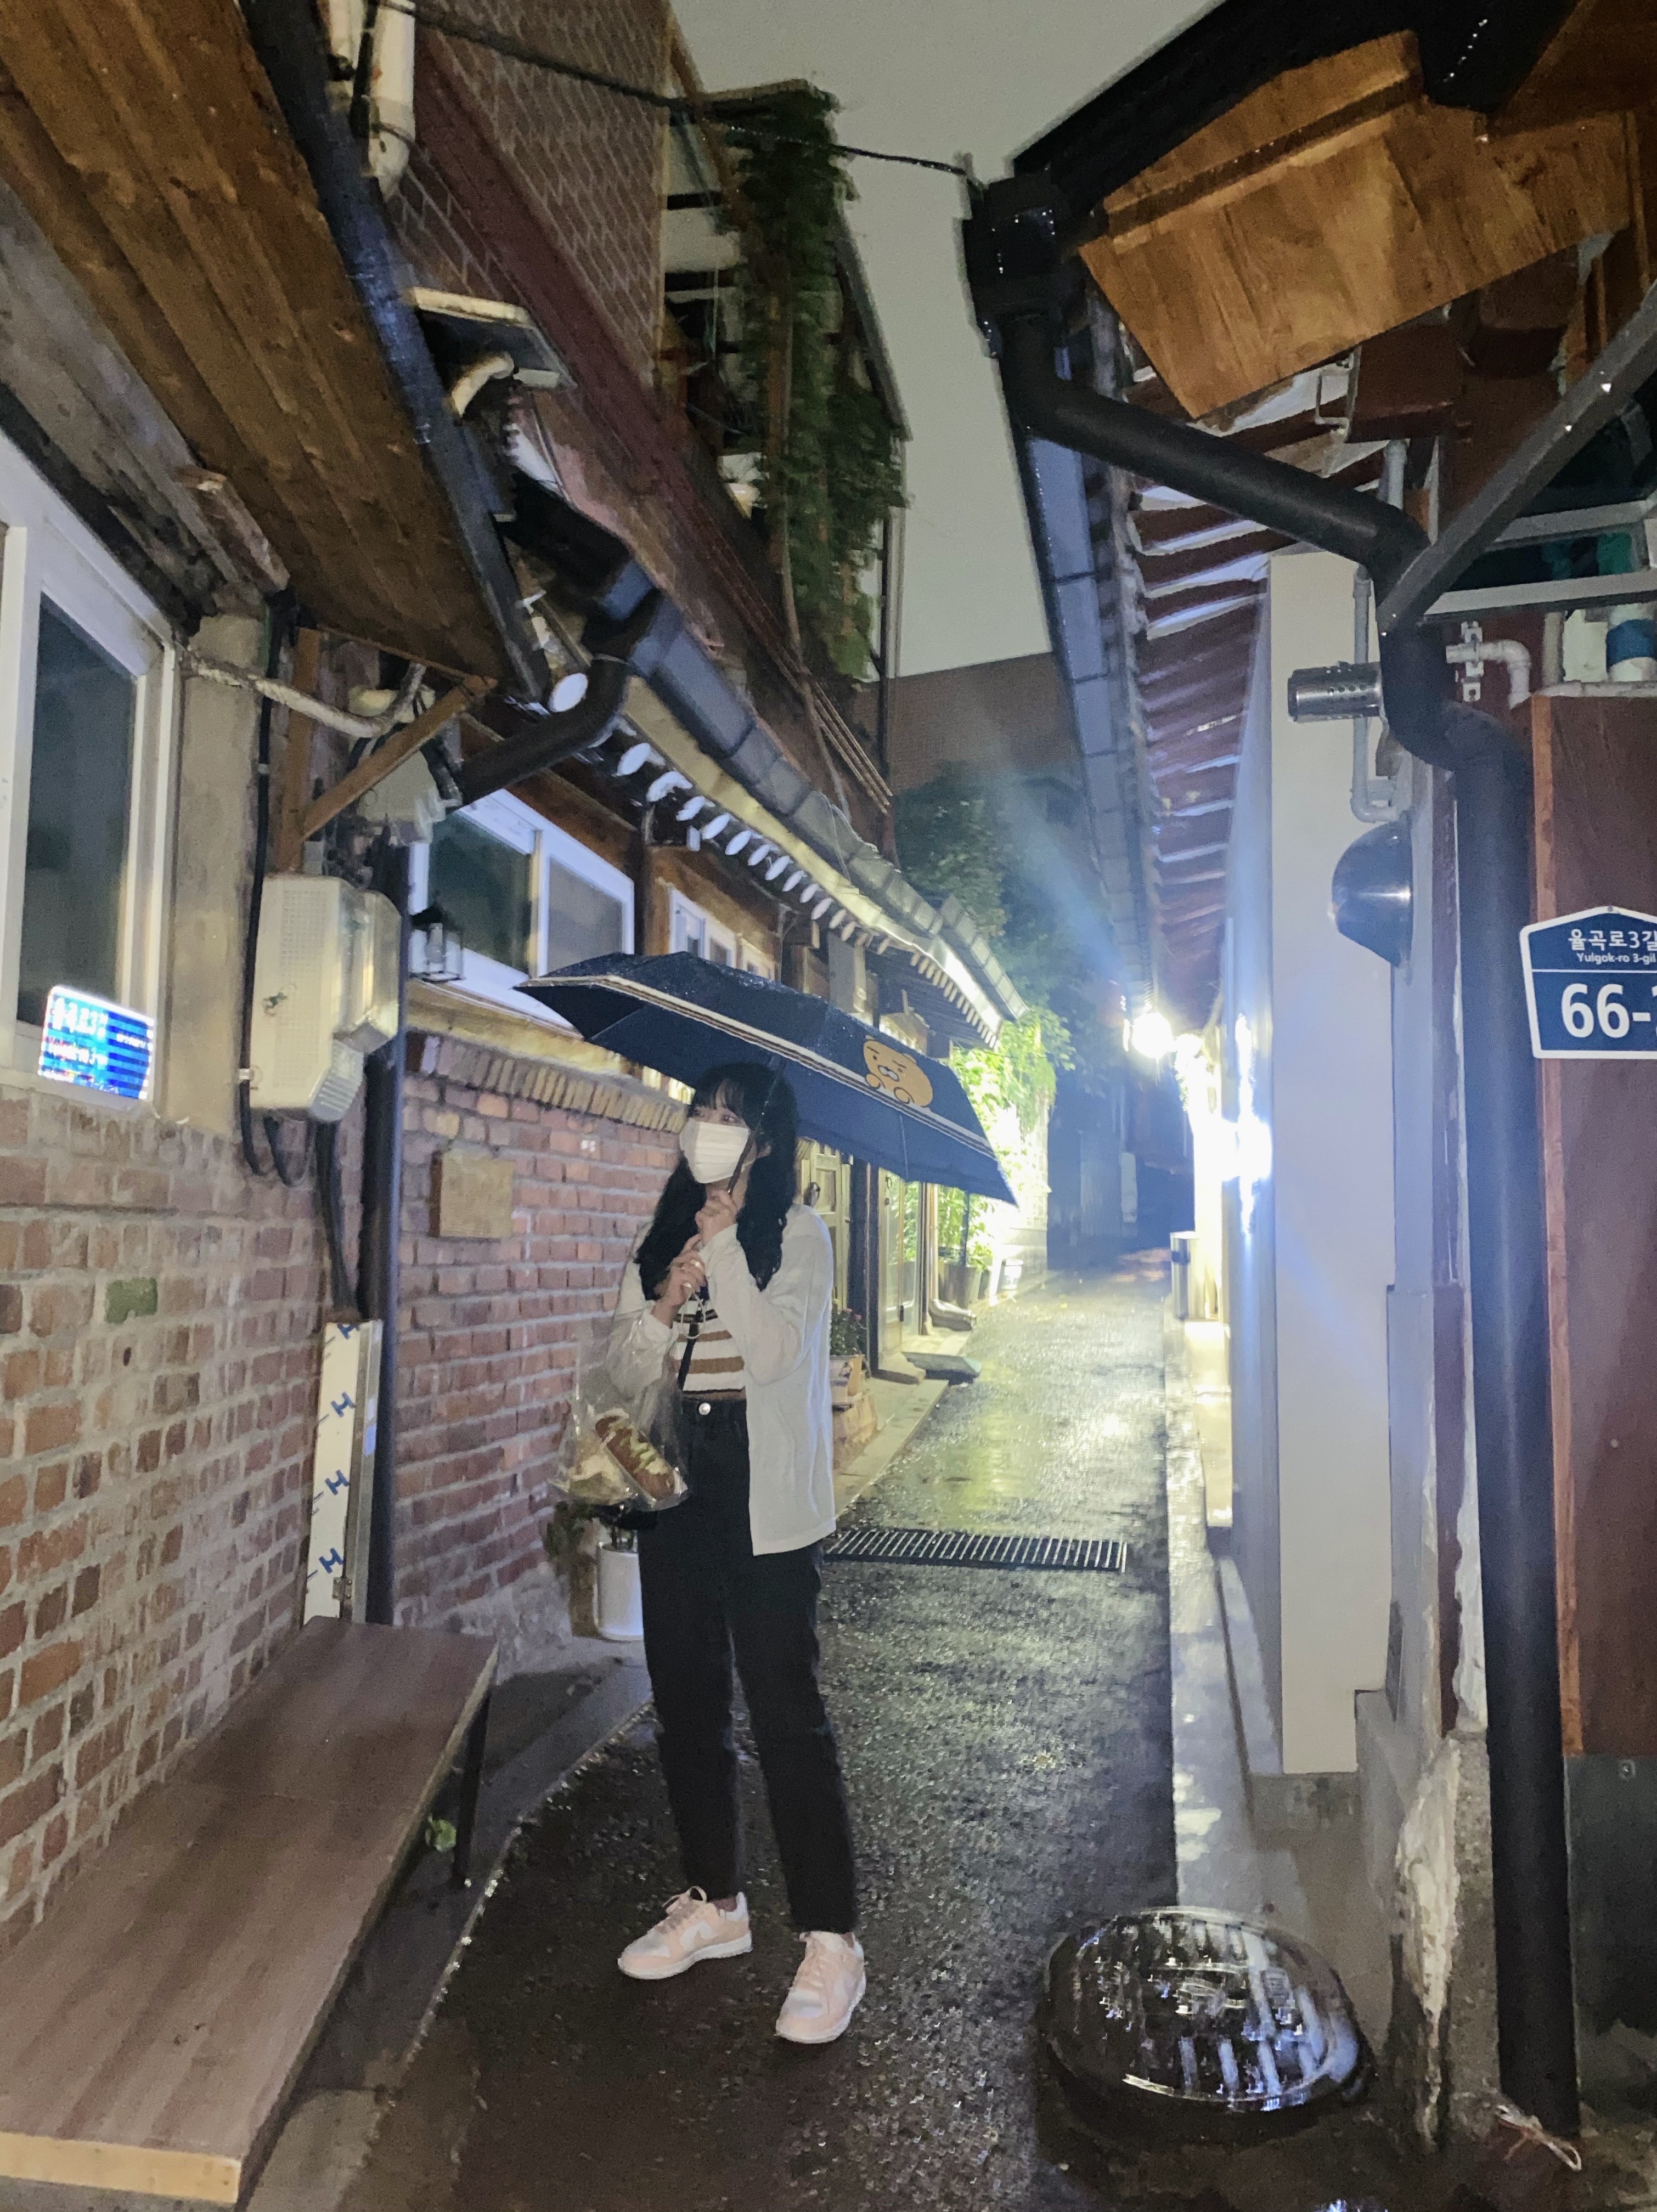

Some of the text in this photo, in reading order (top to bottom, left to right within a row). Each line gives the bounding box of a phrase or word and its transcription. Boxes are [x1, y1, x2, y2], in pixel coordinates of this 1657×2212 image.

[1568, 929, 1657, 951] 율곡로3길
[1576, 952, 1656, 964] Yulgok-ro 3-gil
[1561, 983, 1657, 1038] 66-
